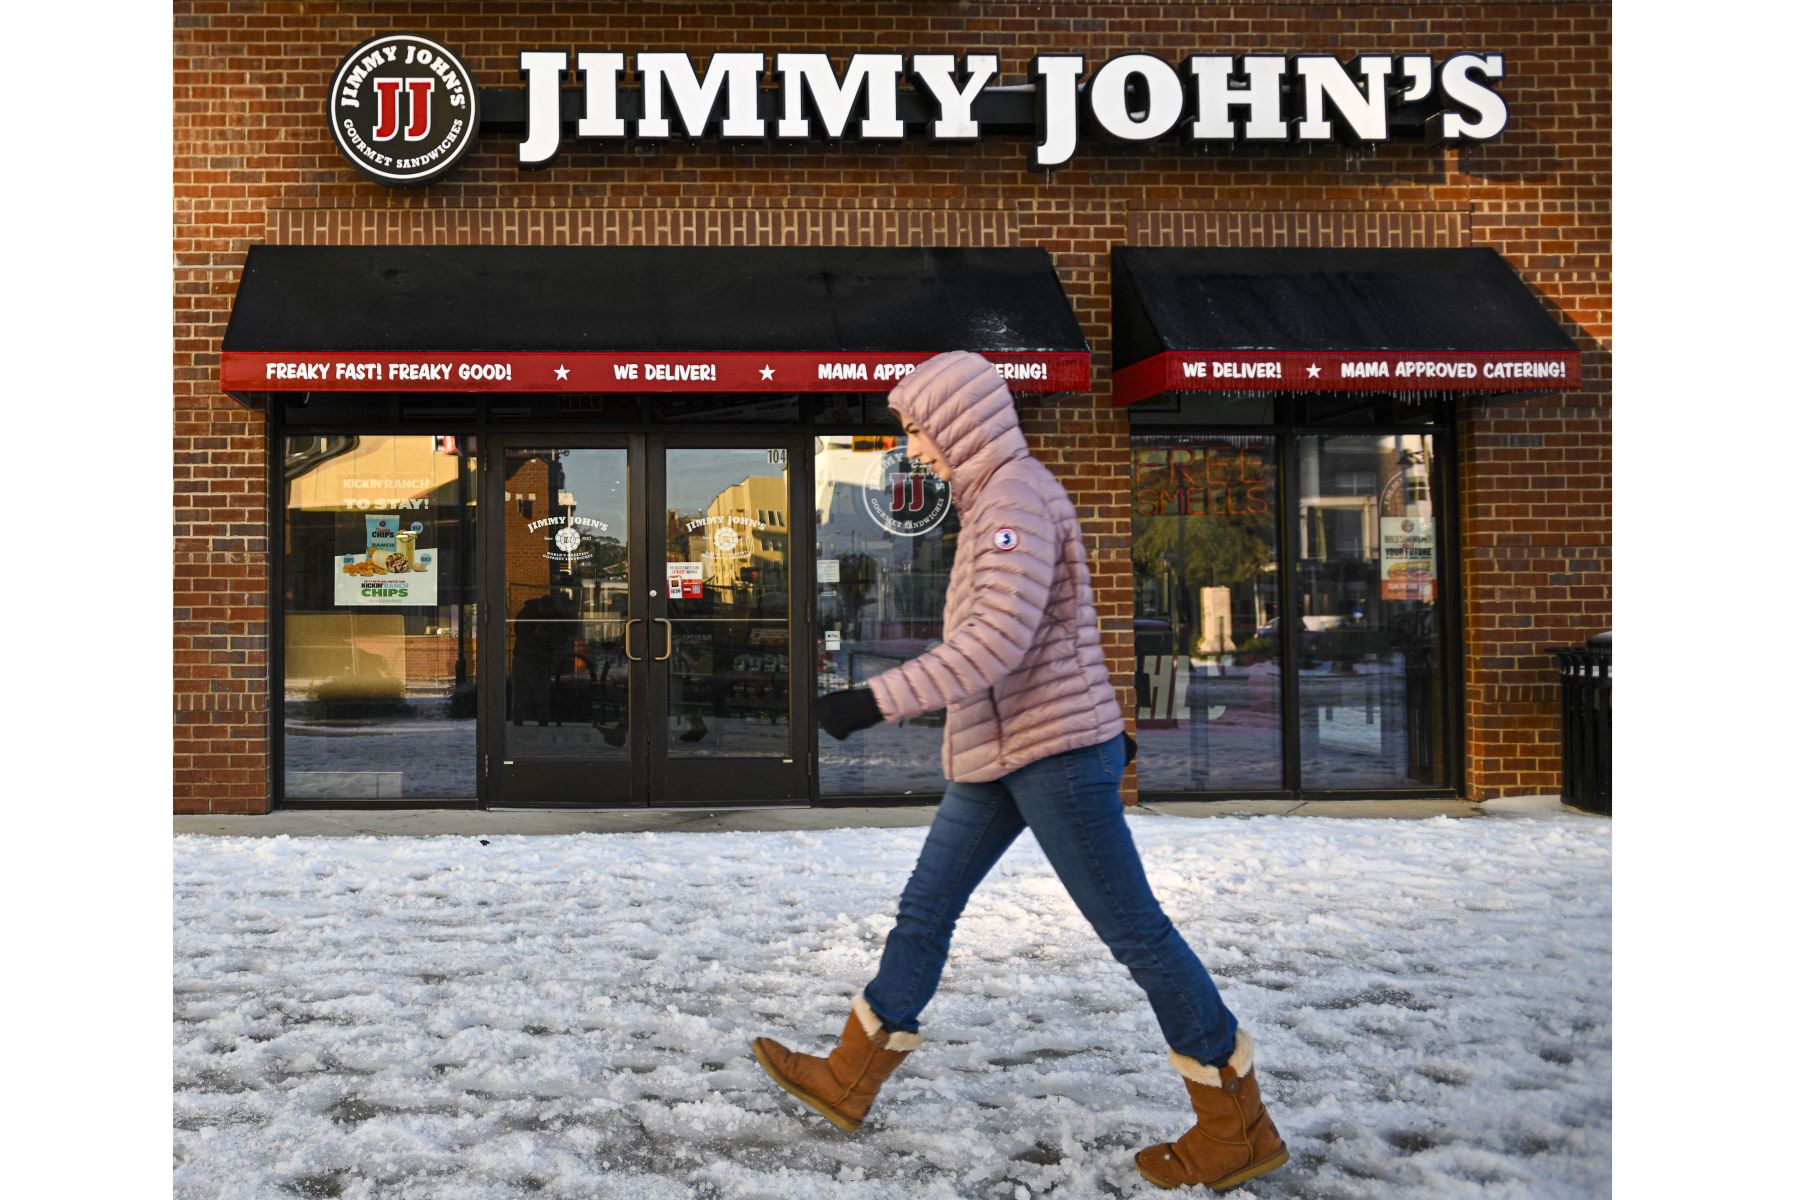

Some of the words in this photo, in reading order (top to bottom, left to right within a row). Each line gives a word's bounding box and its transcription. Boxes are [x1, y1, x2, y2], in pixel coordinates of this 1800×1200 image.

[341, 45, 398, 108] JIMMY
[405, 45, 465, 107] JOHN'S
[373, 78, 435, 142] JJ
[520, 52, 997, 162] JIMMY
[1037, 54, 1507, 165] JOHN'S
[344, 119, 392, 167] GOURMET
[396, 119, 463, 169] SANDWICHES
[266, 363, 331, 380] FREAKY
[335, 363, 383, 380] FAST!
[388, 363, 453, 380] FREAKY
[458, 363, 512, 381] GOOD!
[613, 364, 639, 380] WE
[645, 364, 717, 381] DELIVER!
[818, 363, 868, 380] MAMA
[873, 363, 921, 380] APPR
[994, 362, 1048, 380] ERING!
[1182, 362, 1207, 378] WE
[1213, 362, 1282, 378] DELIVER!
[1341, 361, 1390, 378] MAMA
[1395, 361, 1478, 378] APPROVED
[1483, 361, 1566, 379] CATERING!
[768, 449, 787, 464] 104
[1136, 446, 1265, 484] FREE
[889, 472, 927, 512] JJ
[1135, 486, 1268, 516] SMELLS
[343, 498, 371, 510] TO
[374, 498, 429, 510] STAY!
[527, 516, 566, 534] JIMMY
[569, 516, 609, 532] JOHN'S
[686, 515, 724, 533] JIMMY
[727, 515, 766, 531] JOHN'S
[1405, 548, 1432, 556] FUTURE
[361, 589, 409, 598] CHIPS
